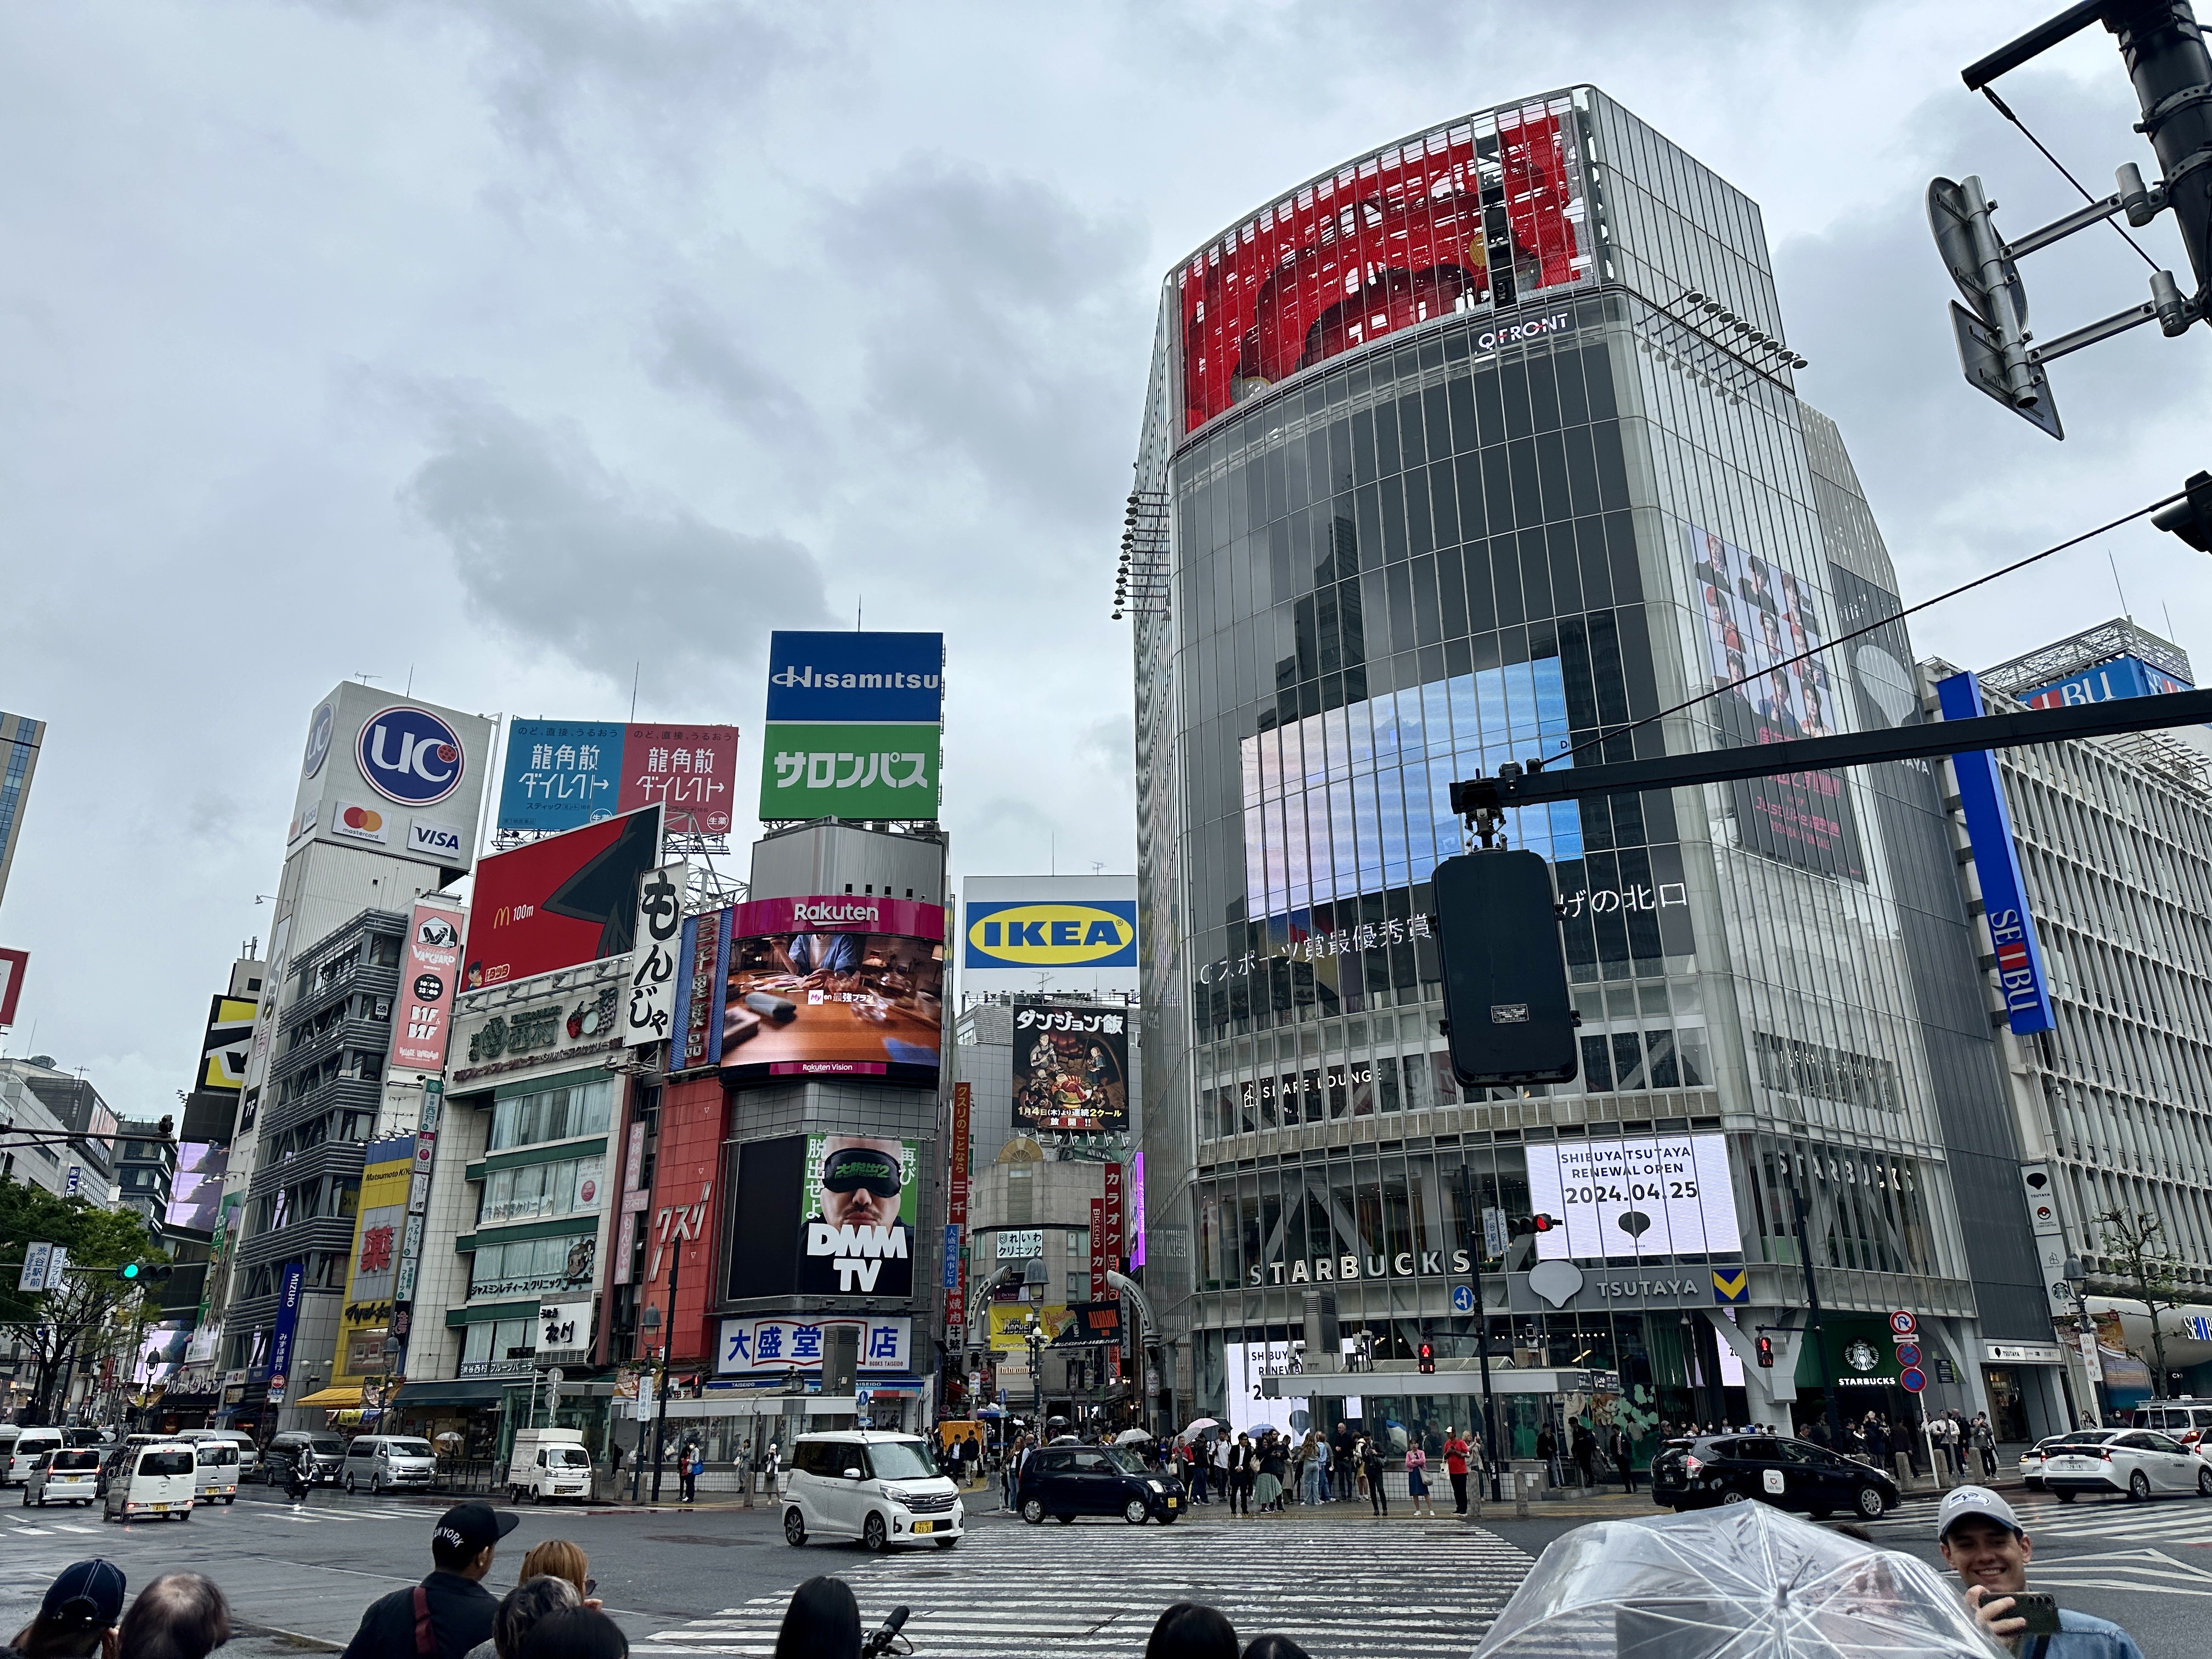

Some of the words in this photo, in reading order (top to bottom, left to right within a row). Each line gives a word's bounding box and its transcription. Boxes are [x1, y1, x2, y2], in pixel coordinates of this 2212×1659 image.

[1477, 312, 1569, 351] QFRONT
[771, 665, 939, 690] Hisamitsu
[517, 726, 619, 738] のど、直接、うるおう
[633, 729, 733, 742] のど、直接、うるおう
[531, 743, 600, 771] 龍角散
[647, 747, 715, 774] 龍角散
[774, 751, 928, 789] サロンパス
[518, 772, 610, 800] ダイレクト
[636, 775, 725, 802] ダイレクト
[342, 827, 380, 840] mastercard
[413, 826, 459, 850] VISA
[513, 904, 534, 921] 100m
[793, 901, 879, 926] Rakuten
[984, 921, 1123, 947] IKEA
[630, 870, 680, 1036] もんじゃ
[1990, 909, 2040, 1014] SEIBU
[410, 1005, 439, 1022] B1F
[1016, 1008, 1124, 1035] ダンジョン飯
[407, 1022, 438, 1040] B2F
[802, 1063, 831, 1072] Rakuten
[245, 1098, 257, 1118] 7F
[955, 1086, 968, 1174] クスリのことなら
[899, 1147, 917, 1186] 再び
[1561, 1151, 1623, 1164] SHIBUYA
[1626, 1146, 1691, 1160] TSUTAYA
[805, 1138, 827, 1219] 脱出せよ
[1572, 1165, 1641, 1179] RENEWAL
[1643, 1163, 1684, 1175] OPEN
[1565, 1181, 1699, 1204] 2024.04.25
[1106, 1172, 1121, 1245] カラオケ
[360, 1226, 394, 1272] 薬
[806, 1223, 908, 1259] DMM
[998, 1245, 1041, 1256] クリニック
[1009, 1232, 1042, 1244] れいわ
[30, 1246, 48, 1287] 渋谷駅前
[832, 1259, 883, 1292] TV
[1250, 1248, 1471, 1286] STARBUCKS
[286, 1273, 300, 1307] MIZUHO
[1596, 1278, 1699, 1297] TSUTAYA
[274, 1333, 287, 1371] みずほ銀行
[727, 1325, 899, 1362] 大盛堂店
[1838, 1377, 1896, 1386] STARBUCKS
[443, 1526, 465, 1548] YORK
